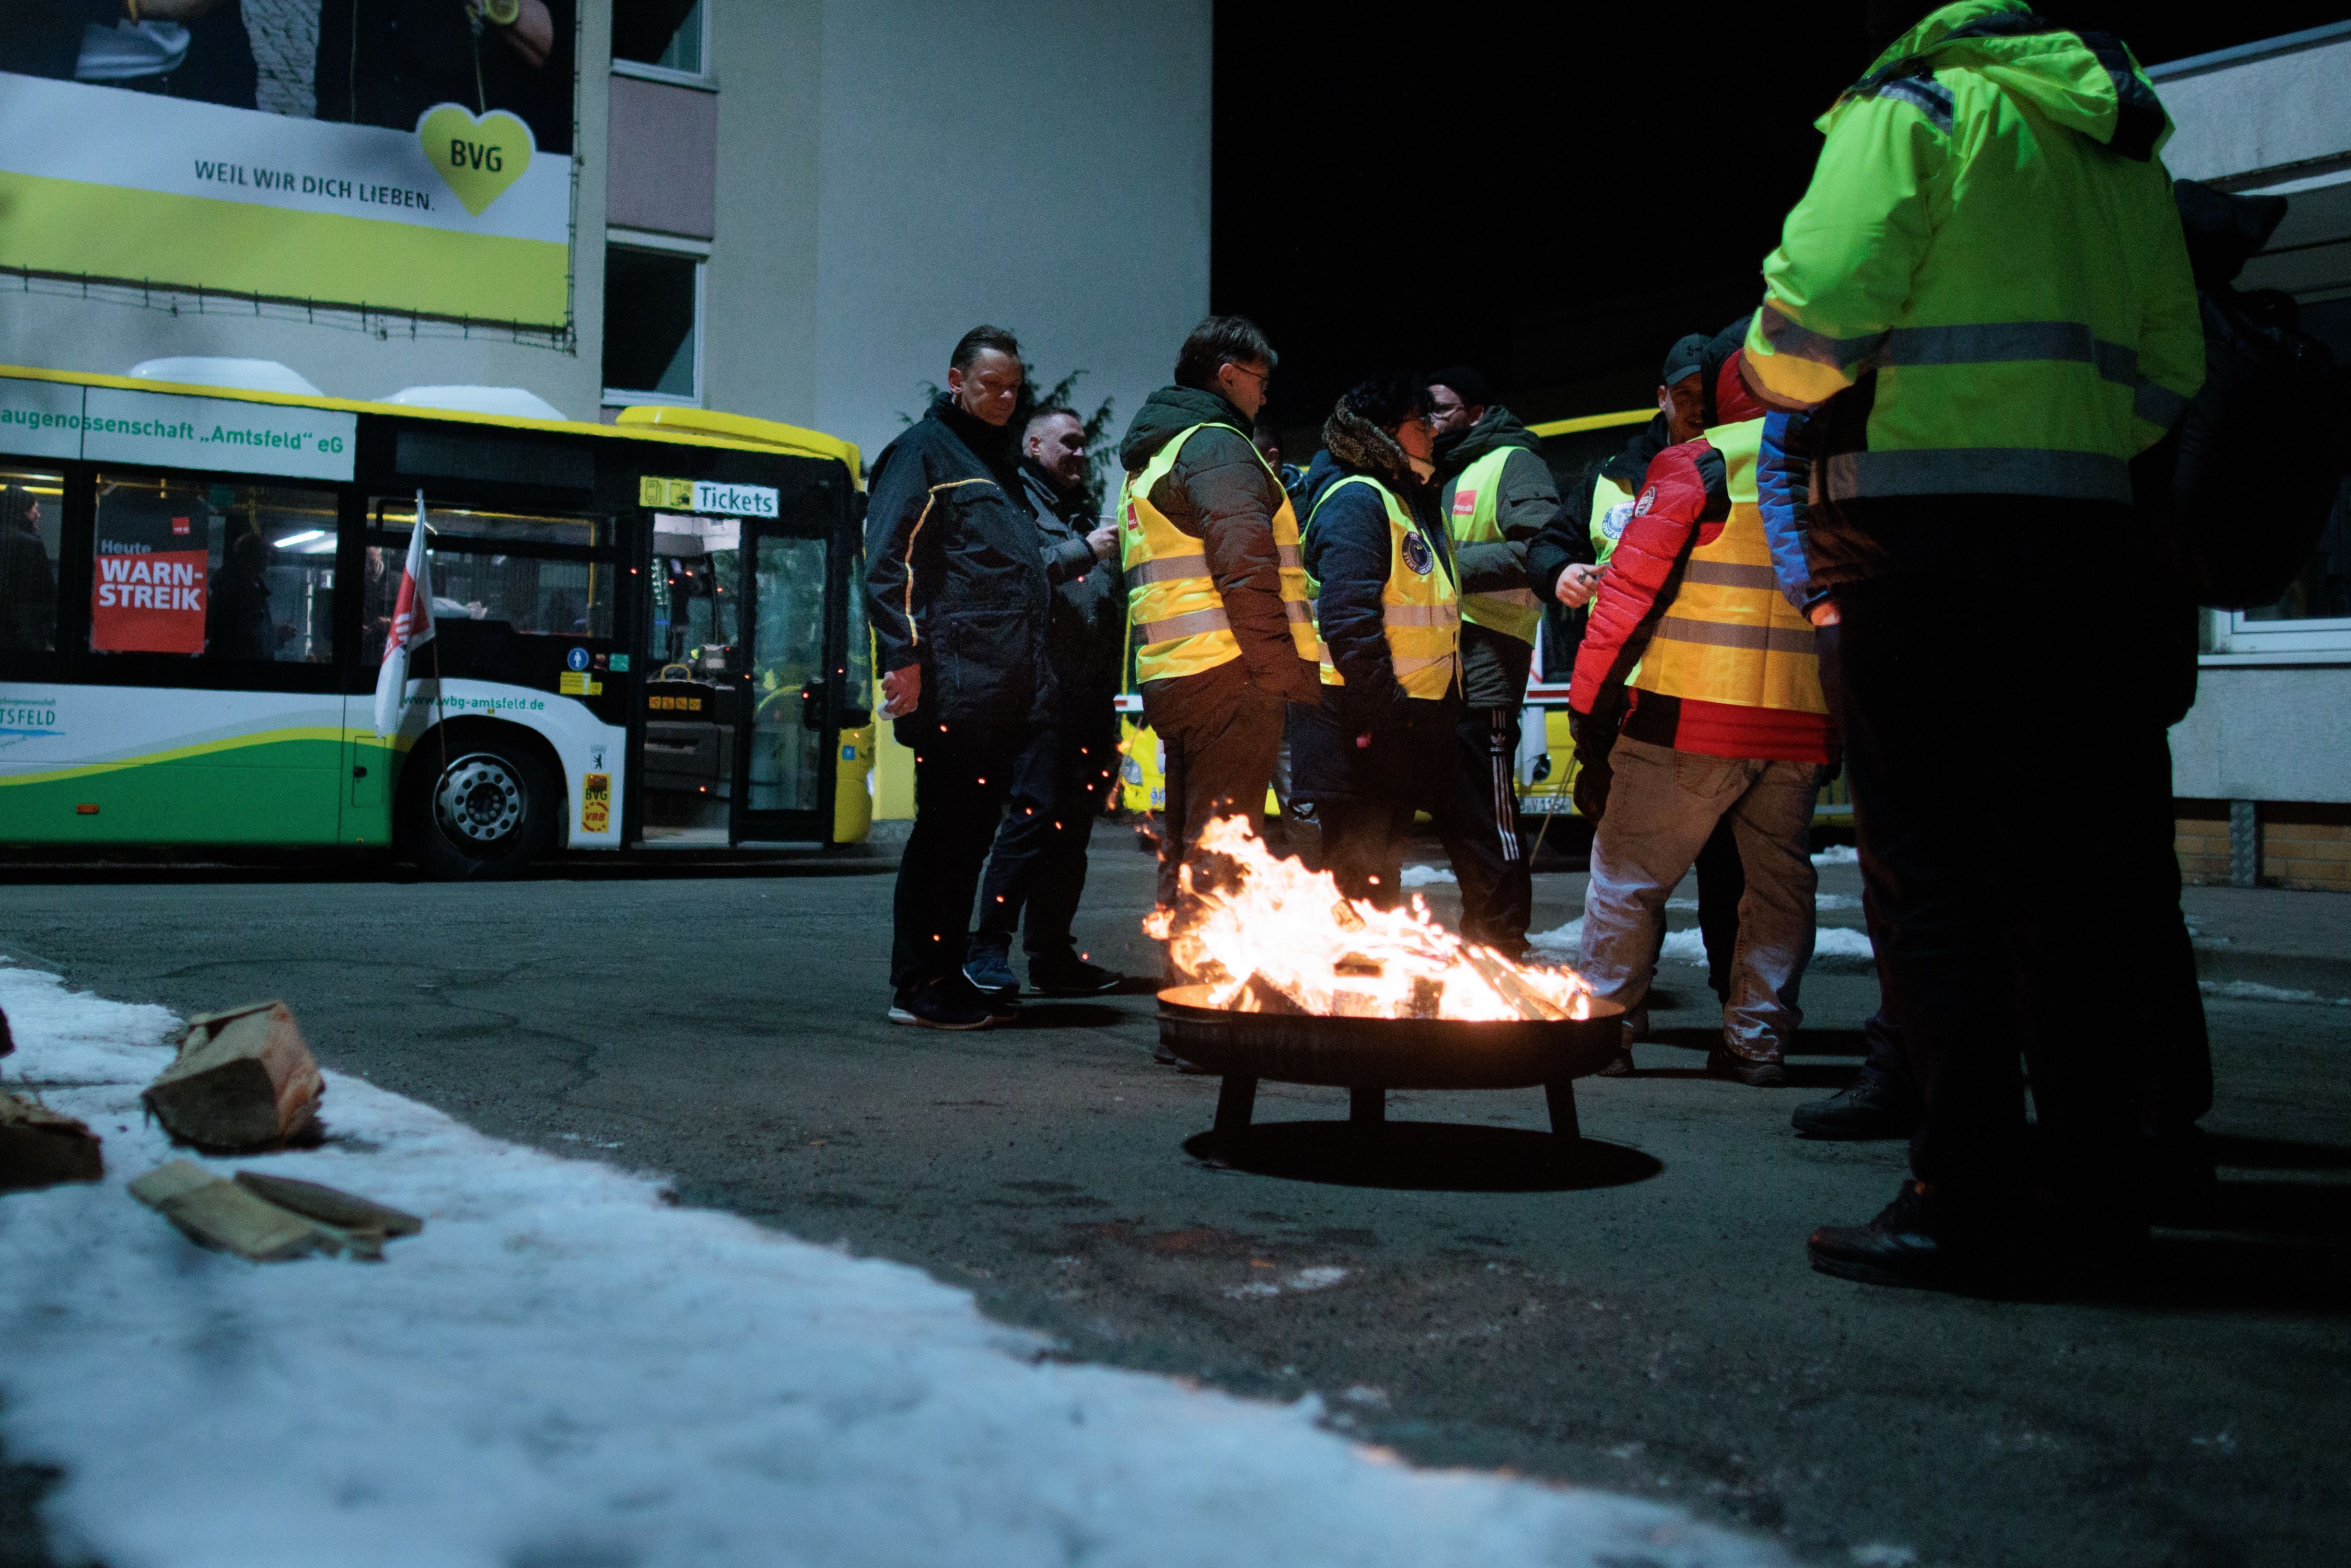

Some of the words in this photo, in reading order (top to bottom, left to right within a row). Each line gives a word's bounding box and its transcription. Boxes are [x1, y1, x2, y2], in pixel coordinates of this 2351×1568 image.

[451, 138, 502, 172] BVG
[194, 159, 248, 185] WEIL
[253, 167, 296, 191] WIR
[302, 175, 352, 198] DICH
[359, 182, 435, 211] LIEBEN.
[1, 409, 194, 440] augenossenschaft
[318, 436, 343, 453] eG
[699, 485, 773, 512] Tickets
[101, 539, 151, 554] Heute
[101, 558, 203, 586] WARN-
[99, 583, 201, 611] STREIK
[586, 788, 607, 800] BVG
[585, 812, 605, 821] VBB
